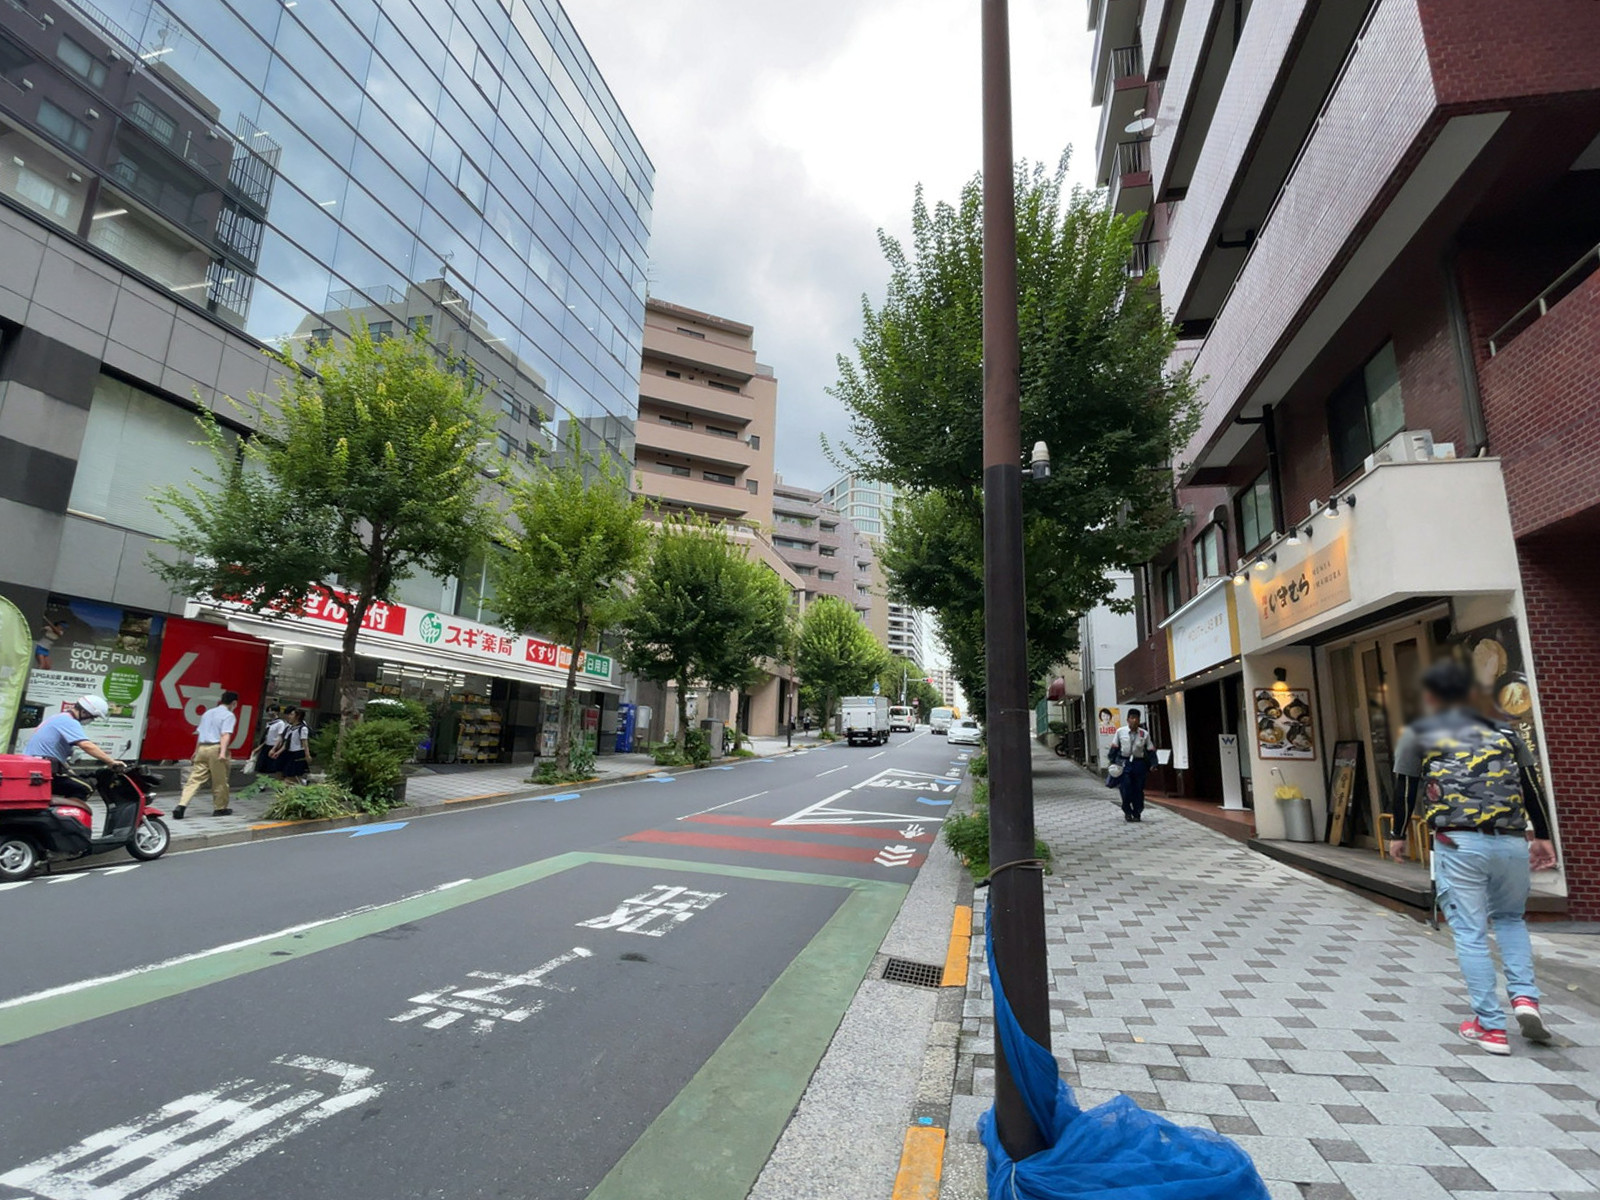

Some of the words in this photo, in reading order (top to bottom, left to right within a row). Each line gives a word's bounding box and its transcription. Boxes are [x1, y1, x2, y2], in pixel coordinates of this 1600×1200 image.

[1268, 573, 1310, 613] いまむら
[445, 625, 513, 656] スギ薬局
[70, 648, 109, 664] GOLF
[110, 652, 147, 666] FUNP
[528, 643, 556, 662] くすり
[70, 658, 109, 673] Tokyo
[587, 658, 608, 675] 日用品
